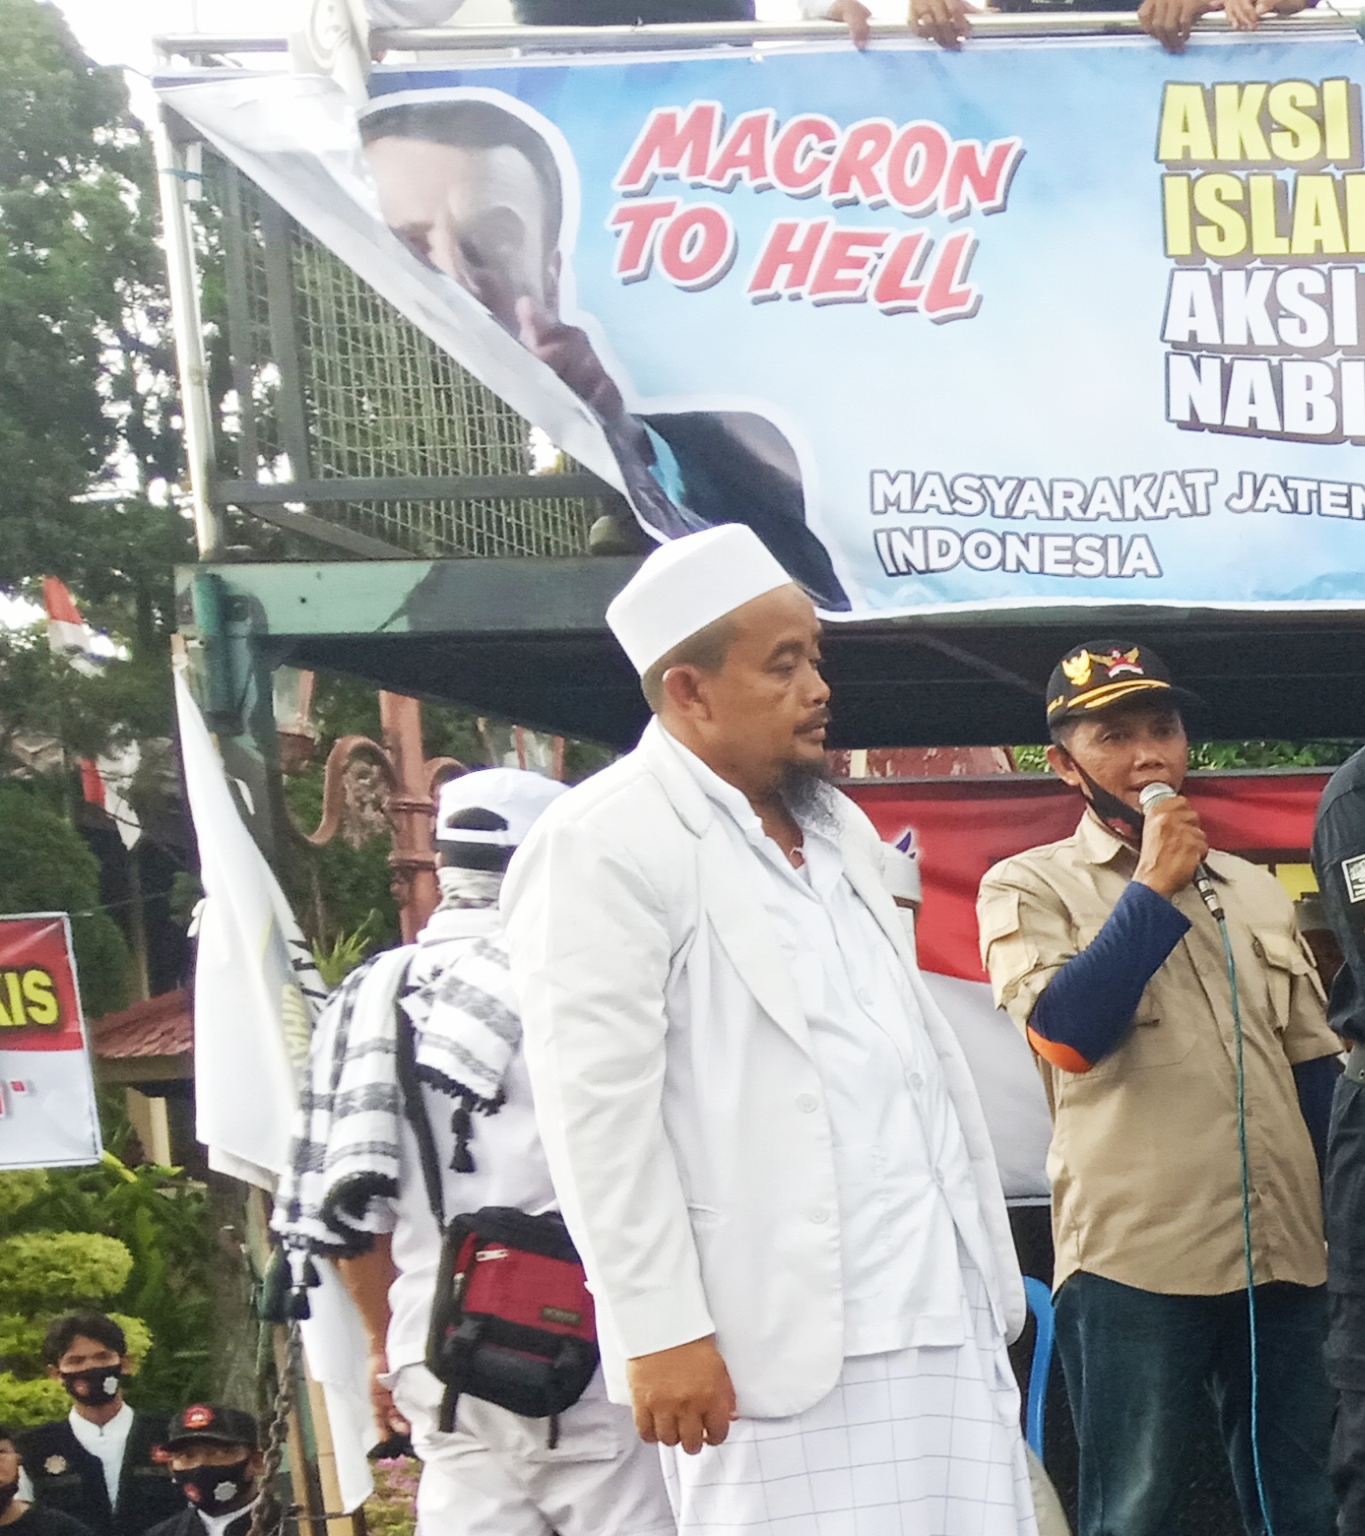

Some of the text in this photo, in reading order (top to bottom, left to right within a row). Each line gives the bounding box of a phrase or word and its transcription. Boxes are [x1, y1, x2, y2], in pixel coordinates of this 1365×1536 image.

[615, 102, 1020, 214] MACRON
[1157, 79, 1352, 162] AKSI
[608, 198, 980, 316] TO HELL
[1162, 267, 1359, 347] AKSI
[870, 470, 1217, 521] MASYARAKAT
[874, 529, 1162, 577] INDONESIA
